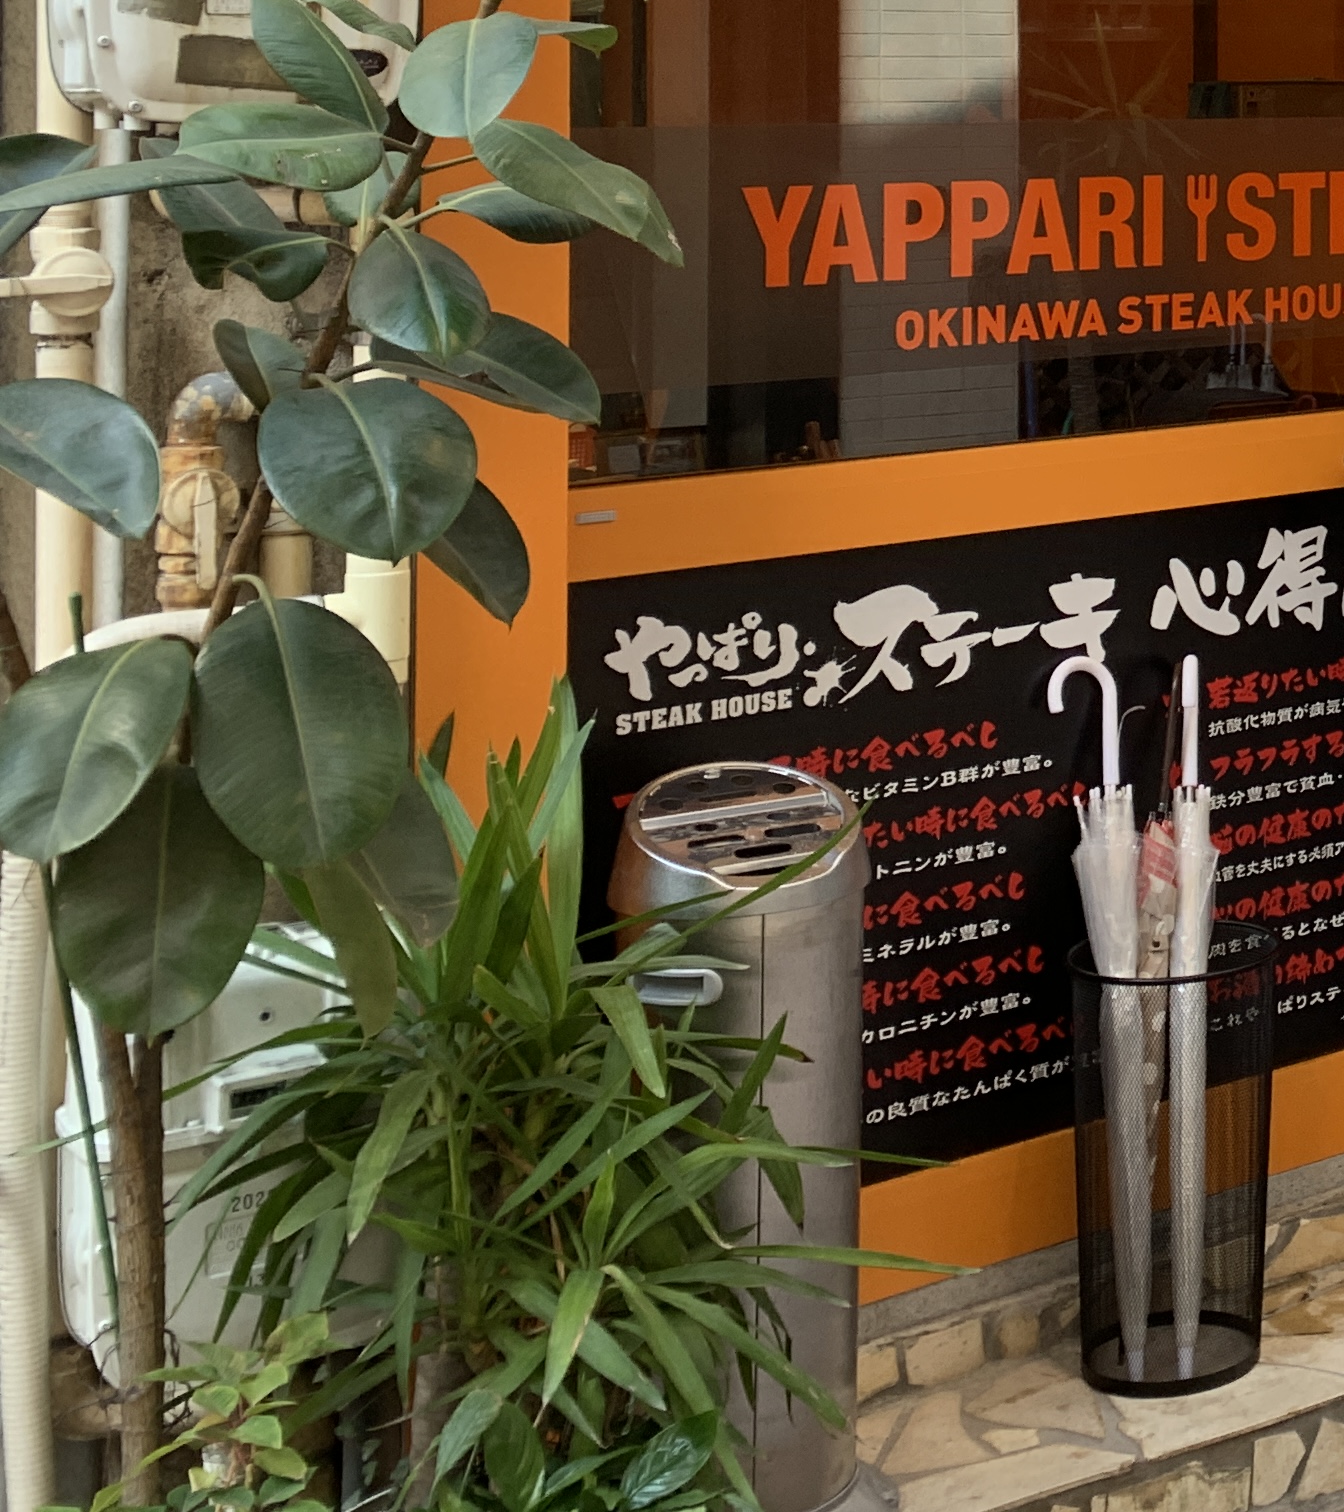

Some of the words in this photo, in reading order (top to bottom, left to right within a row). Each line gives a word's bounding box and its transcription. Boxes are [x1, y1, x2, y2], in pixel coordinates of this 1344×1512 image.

[741, 174, 1164, 288] YAPPARI
[895, 298, 1107, 351] OKINAWA
[1117, 287, 1255, 335] STEAK
[615, 702, 703, 736] STEAK
[711, 689, 793, 721] HOUSE
[875, 841, 1007, 880] トニンが豊富。
[862, 919, 1011, 963] ミネラルが豊富。
[866, 1016, 1073, 1090] い時に食べるべ
[232, 1191, 265, 1213] 202
